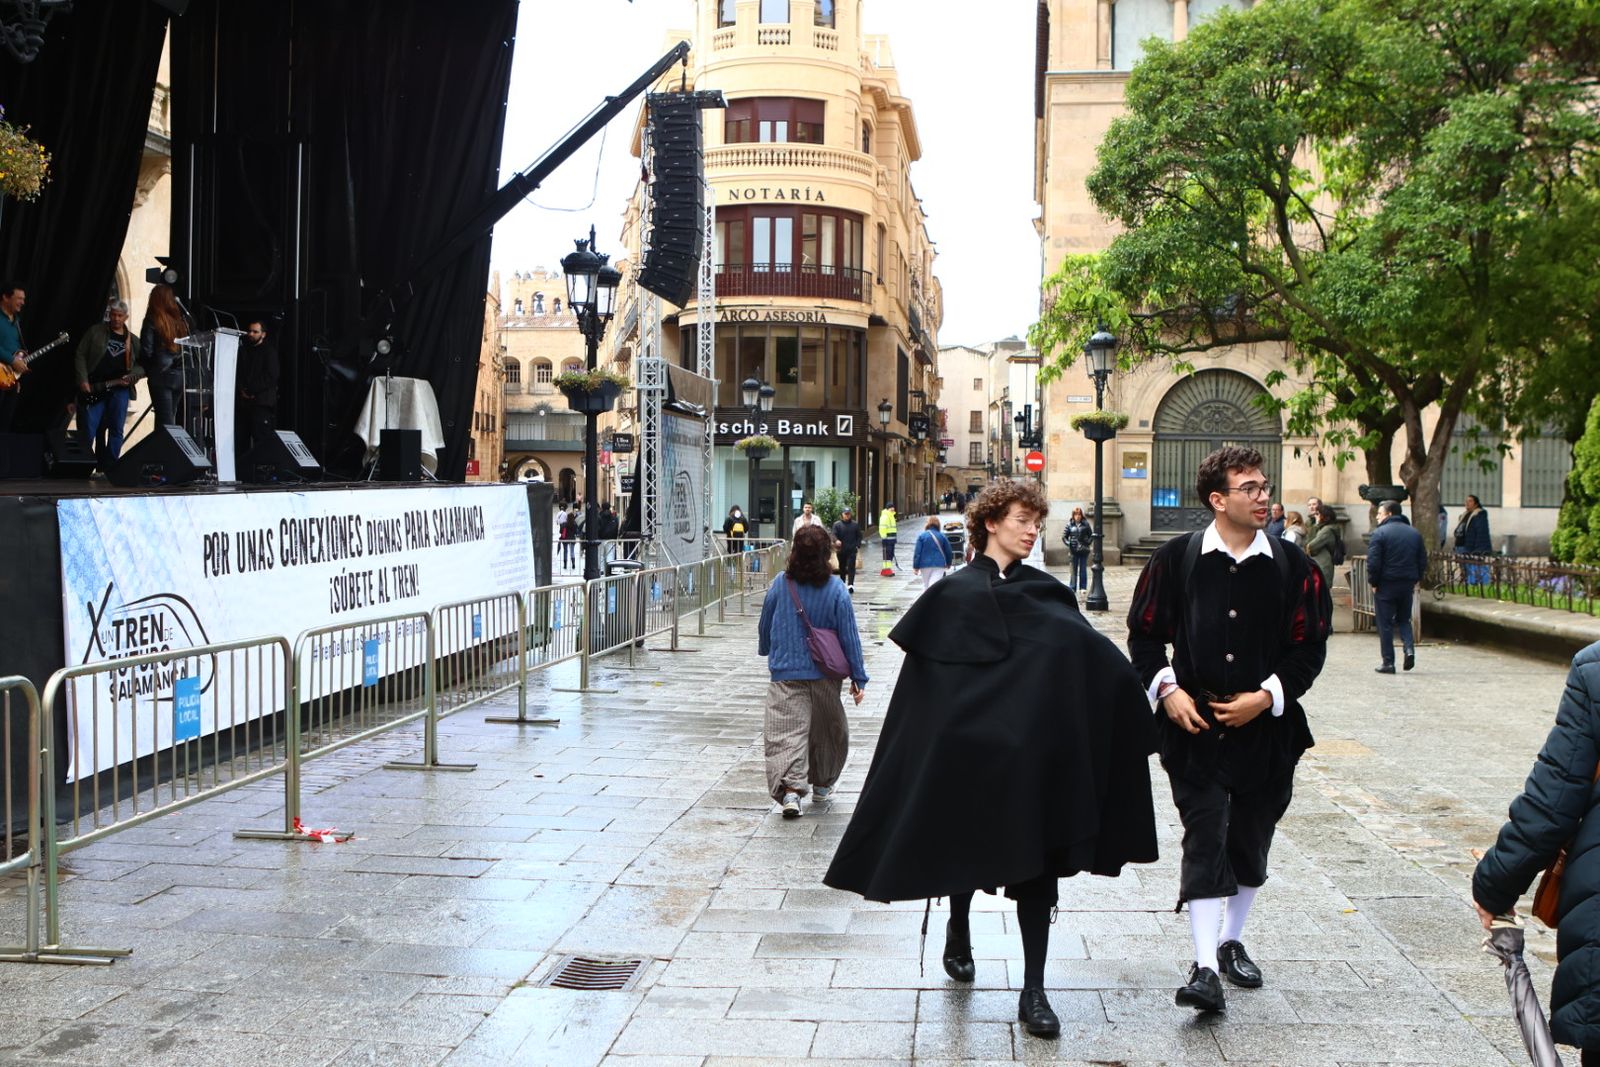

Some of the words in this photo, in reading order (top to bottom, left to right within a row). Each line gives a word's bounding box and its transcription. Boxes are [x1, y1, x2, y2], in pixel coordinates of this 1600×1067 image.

[729, 187, 825, 202] NOTARÍA
[720, 309, 759, 322] ARCO
[778, 420, 829, 435] Bank
[203, 531, 231, 578] POR
[236, 528, 275, 573] UNAS
[280, 514, 363, 567] CONEXIONES
[366, 519, 402, 556] DIGNAS
[404, 510, 431, 550] PARA
[432, 505, 485, 546] SALAMANCA
[330, 567, 375, 614] ¡SÚBETE
[378, 566, 391, 604] AL
[392, 563, 420, 600] TREN!
[101, 631, 115, 645] UN
[112, 612, 164, 650] TREN
[164, 627, 174, 641] DE
